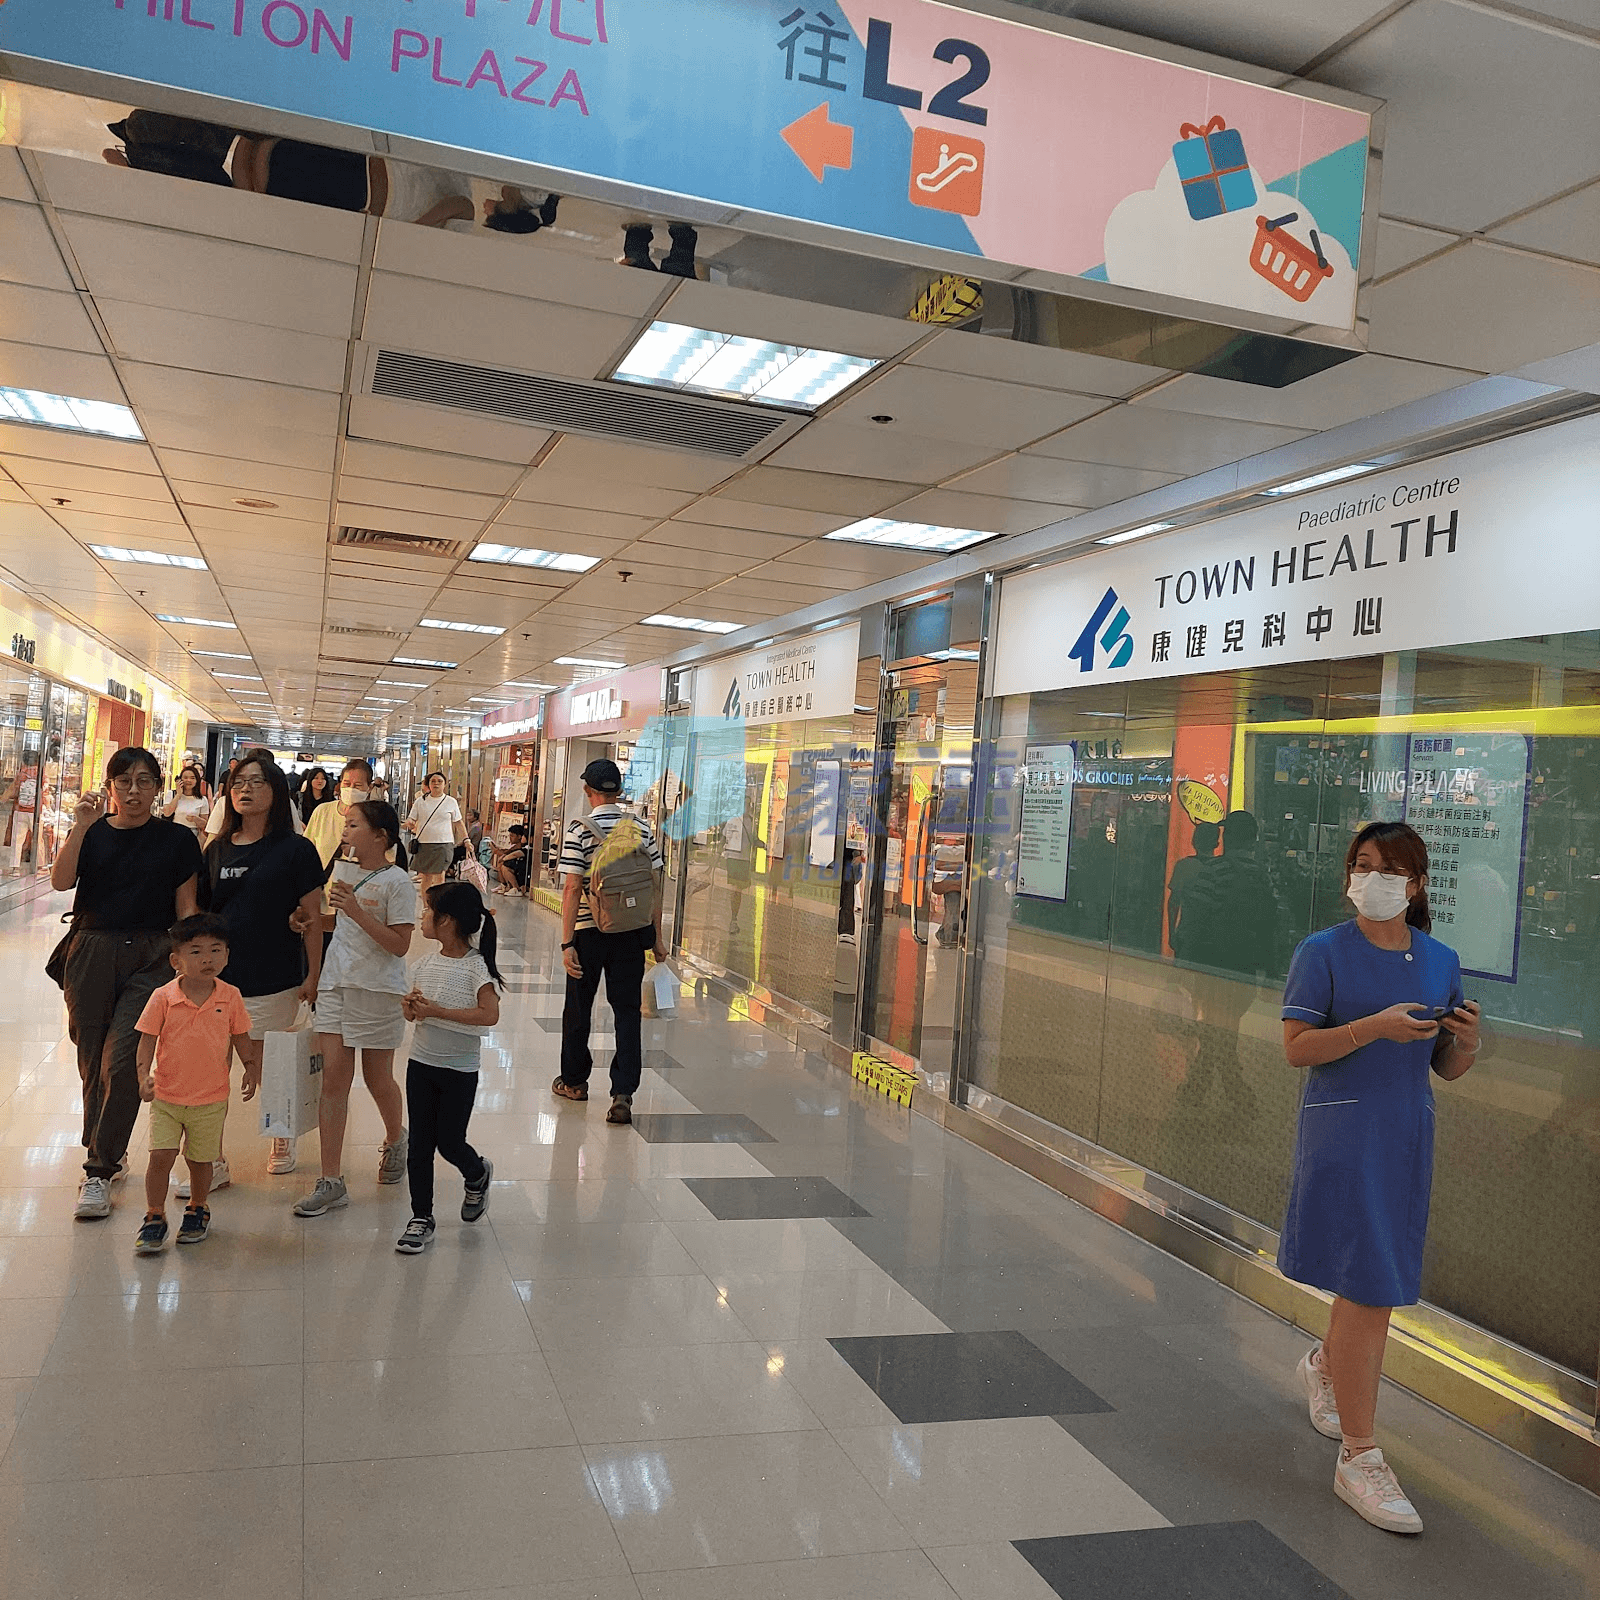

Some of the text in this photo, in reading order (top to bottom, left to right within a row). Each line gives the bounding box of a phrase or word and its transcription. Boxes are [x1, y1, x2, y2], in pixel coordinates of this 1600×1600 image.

[115, 0, 590, 117] LTON PLAZA
[776, 6, 991, 127] 往 L2
[1296, 475, 1460, 531] Paediatric Centre
[1153, 508, 1460, 609] TOWN HEALTH
[1151, 595, 1384, 663] 康健兒科中心
[745, 659, 816, 691] TOWN HEALTH
[1413, 738, 1453, 753] 服務範圍
[1359, 769, 1406, 793] LIVING
[1428, 858, 1459, 872] 癌疫苗
